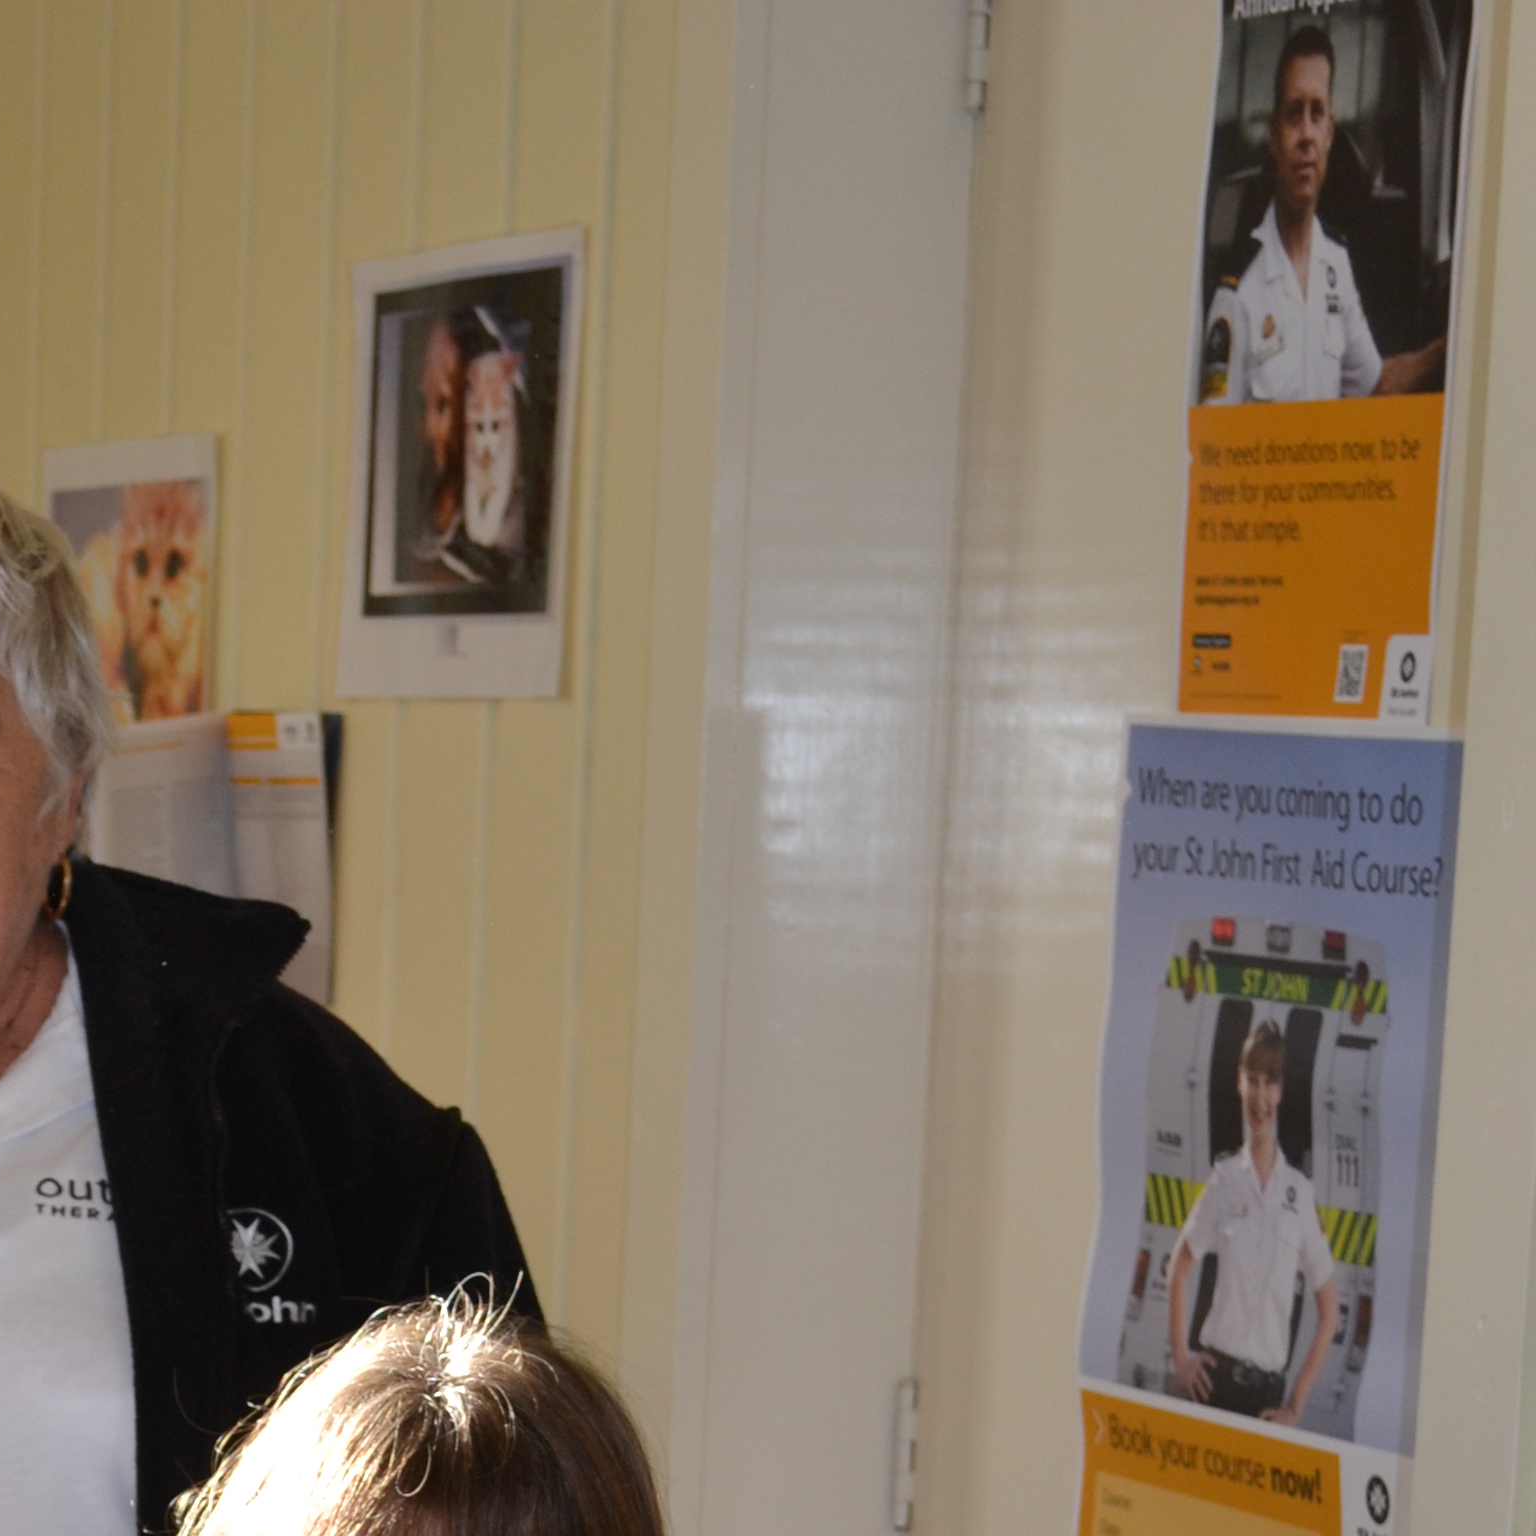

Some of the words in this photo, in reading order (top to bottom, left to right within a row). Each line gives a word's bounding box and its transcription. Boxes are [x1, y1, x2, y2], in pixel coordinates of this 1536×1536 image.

[1139, 767, 1196, 809] When
[1201, 780, 1229, 812] are
[1235, 783, 1271, 822] you
[1275, 780, 1350, 832] coming
[1358, 787, 1383, 823] to
[1390, 782, 1423, 826] do
[1131, 841, 1179, 880] your
[1184, 836, 1204, 876] St
[1207, 838, 1255, 881] John
[1261, 843, 1301, 886] First
[1311, 849, 1345, 890] Aid
[1351, 851, 1444, 897] Course?
[1242, 967, 1263, 997] ST
[1264, 970, 1309, 1003] JOHN
[1109, 1413, 1154, 1457] Book
[1159, 1437, 1200, 1471] your
[1204, 1447, 1265, 1490] course
[1270, 1465, 1322, 1504] now!
